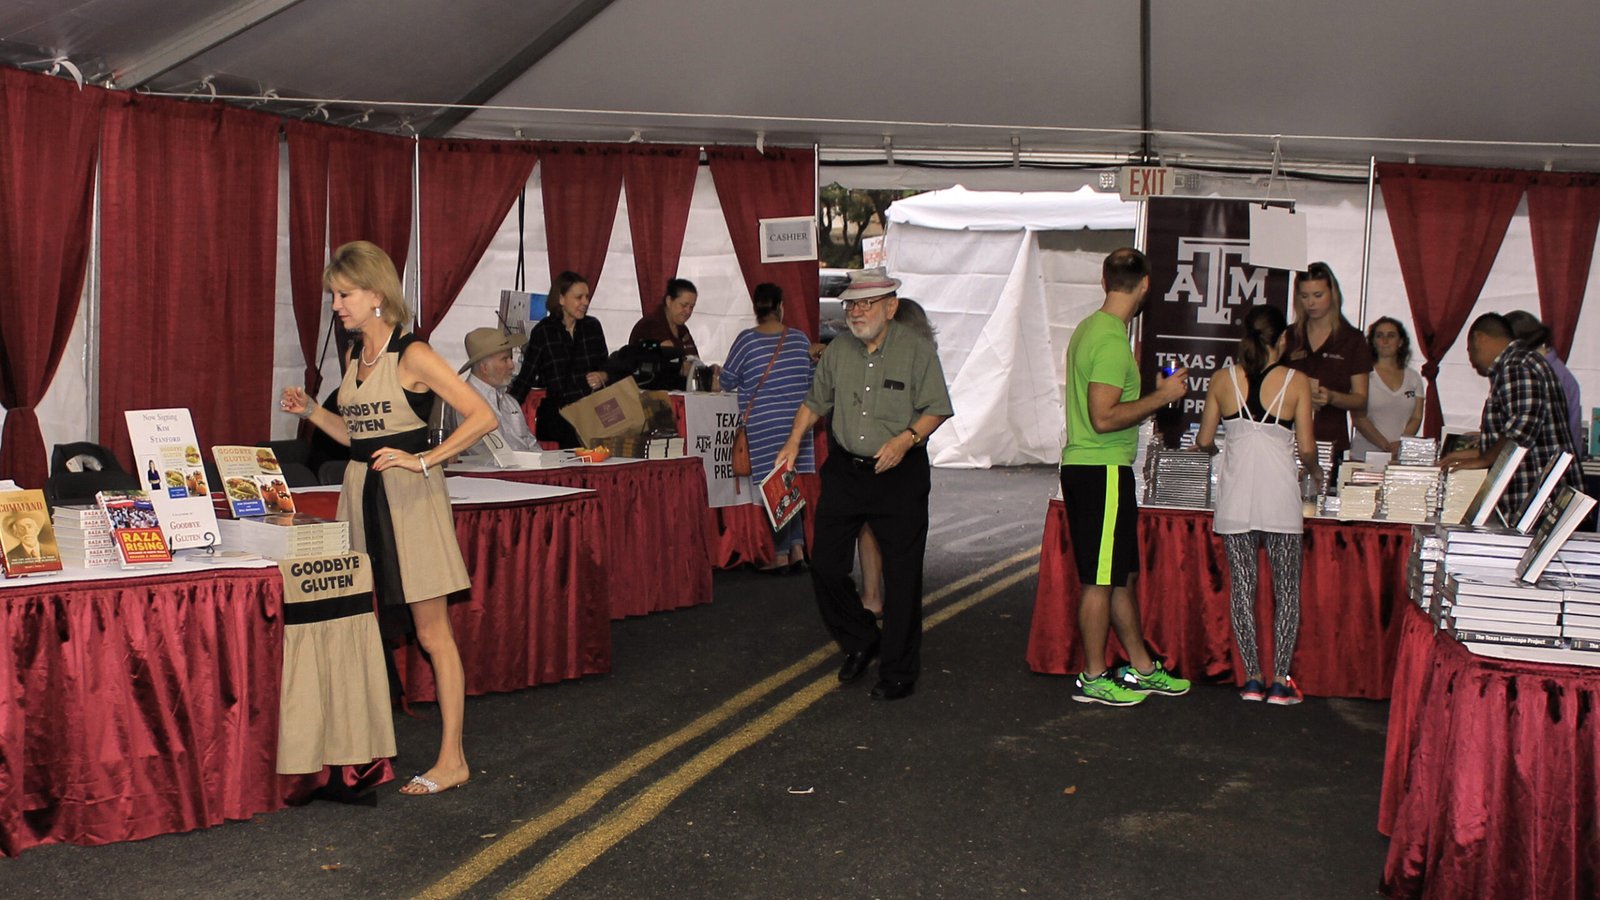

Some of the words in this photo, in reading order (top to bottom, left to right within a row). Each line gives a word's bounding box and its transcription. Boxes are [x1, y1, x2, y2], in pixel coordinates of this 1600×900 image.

[1129, 168, 1166, 195] EXIT
[769, 232, 807, 241] CASHIER
[1155, 352, 1216, 370] TEXAS
[346, 418, 385, 433] GUTEN
[716, 413, 742, 428] TEXA
[714, 464, 737, 480] PRE
[170, 521, 201, 530] GOODBYE
[122, 532, 161, 543] RAZA
[175, 533, 201, 542] GLUTEN
[125, 542, 164, 551] RISING
[291, 556, 359, 577] GOODBYE
[301, 574, 353, 593] GLUTEN
[1500, 636, 1527, 644] Landscape
[1527, 637, 1546, 645] Project
